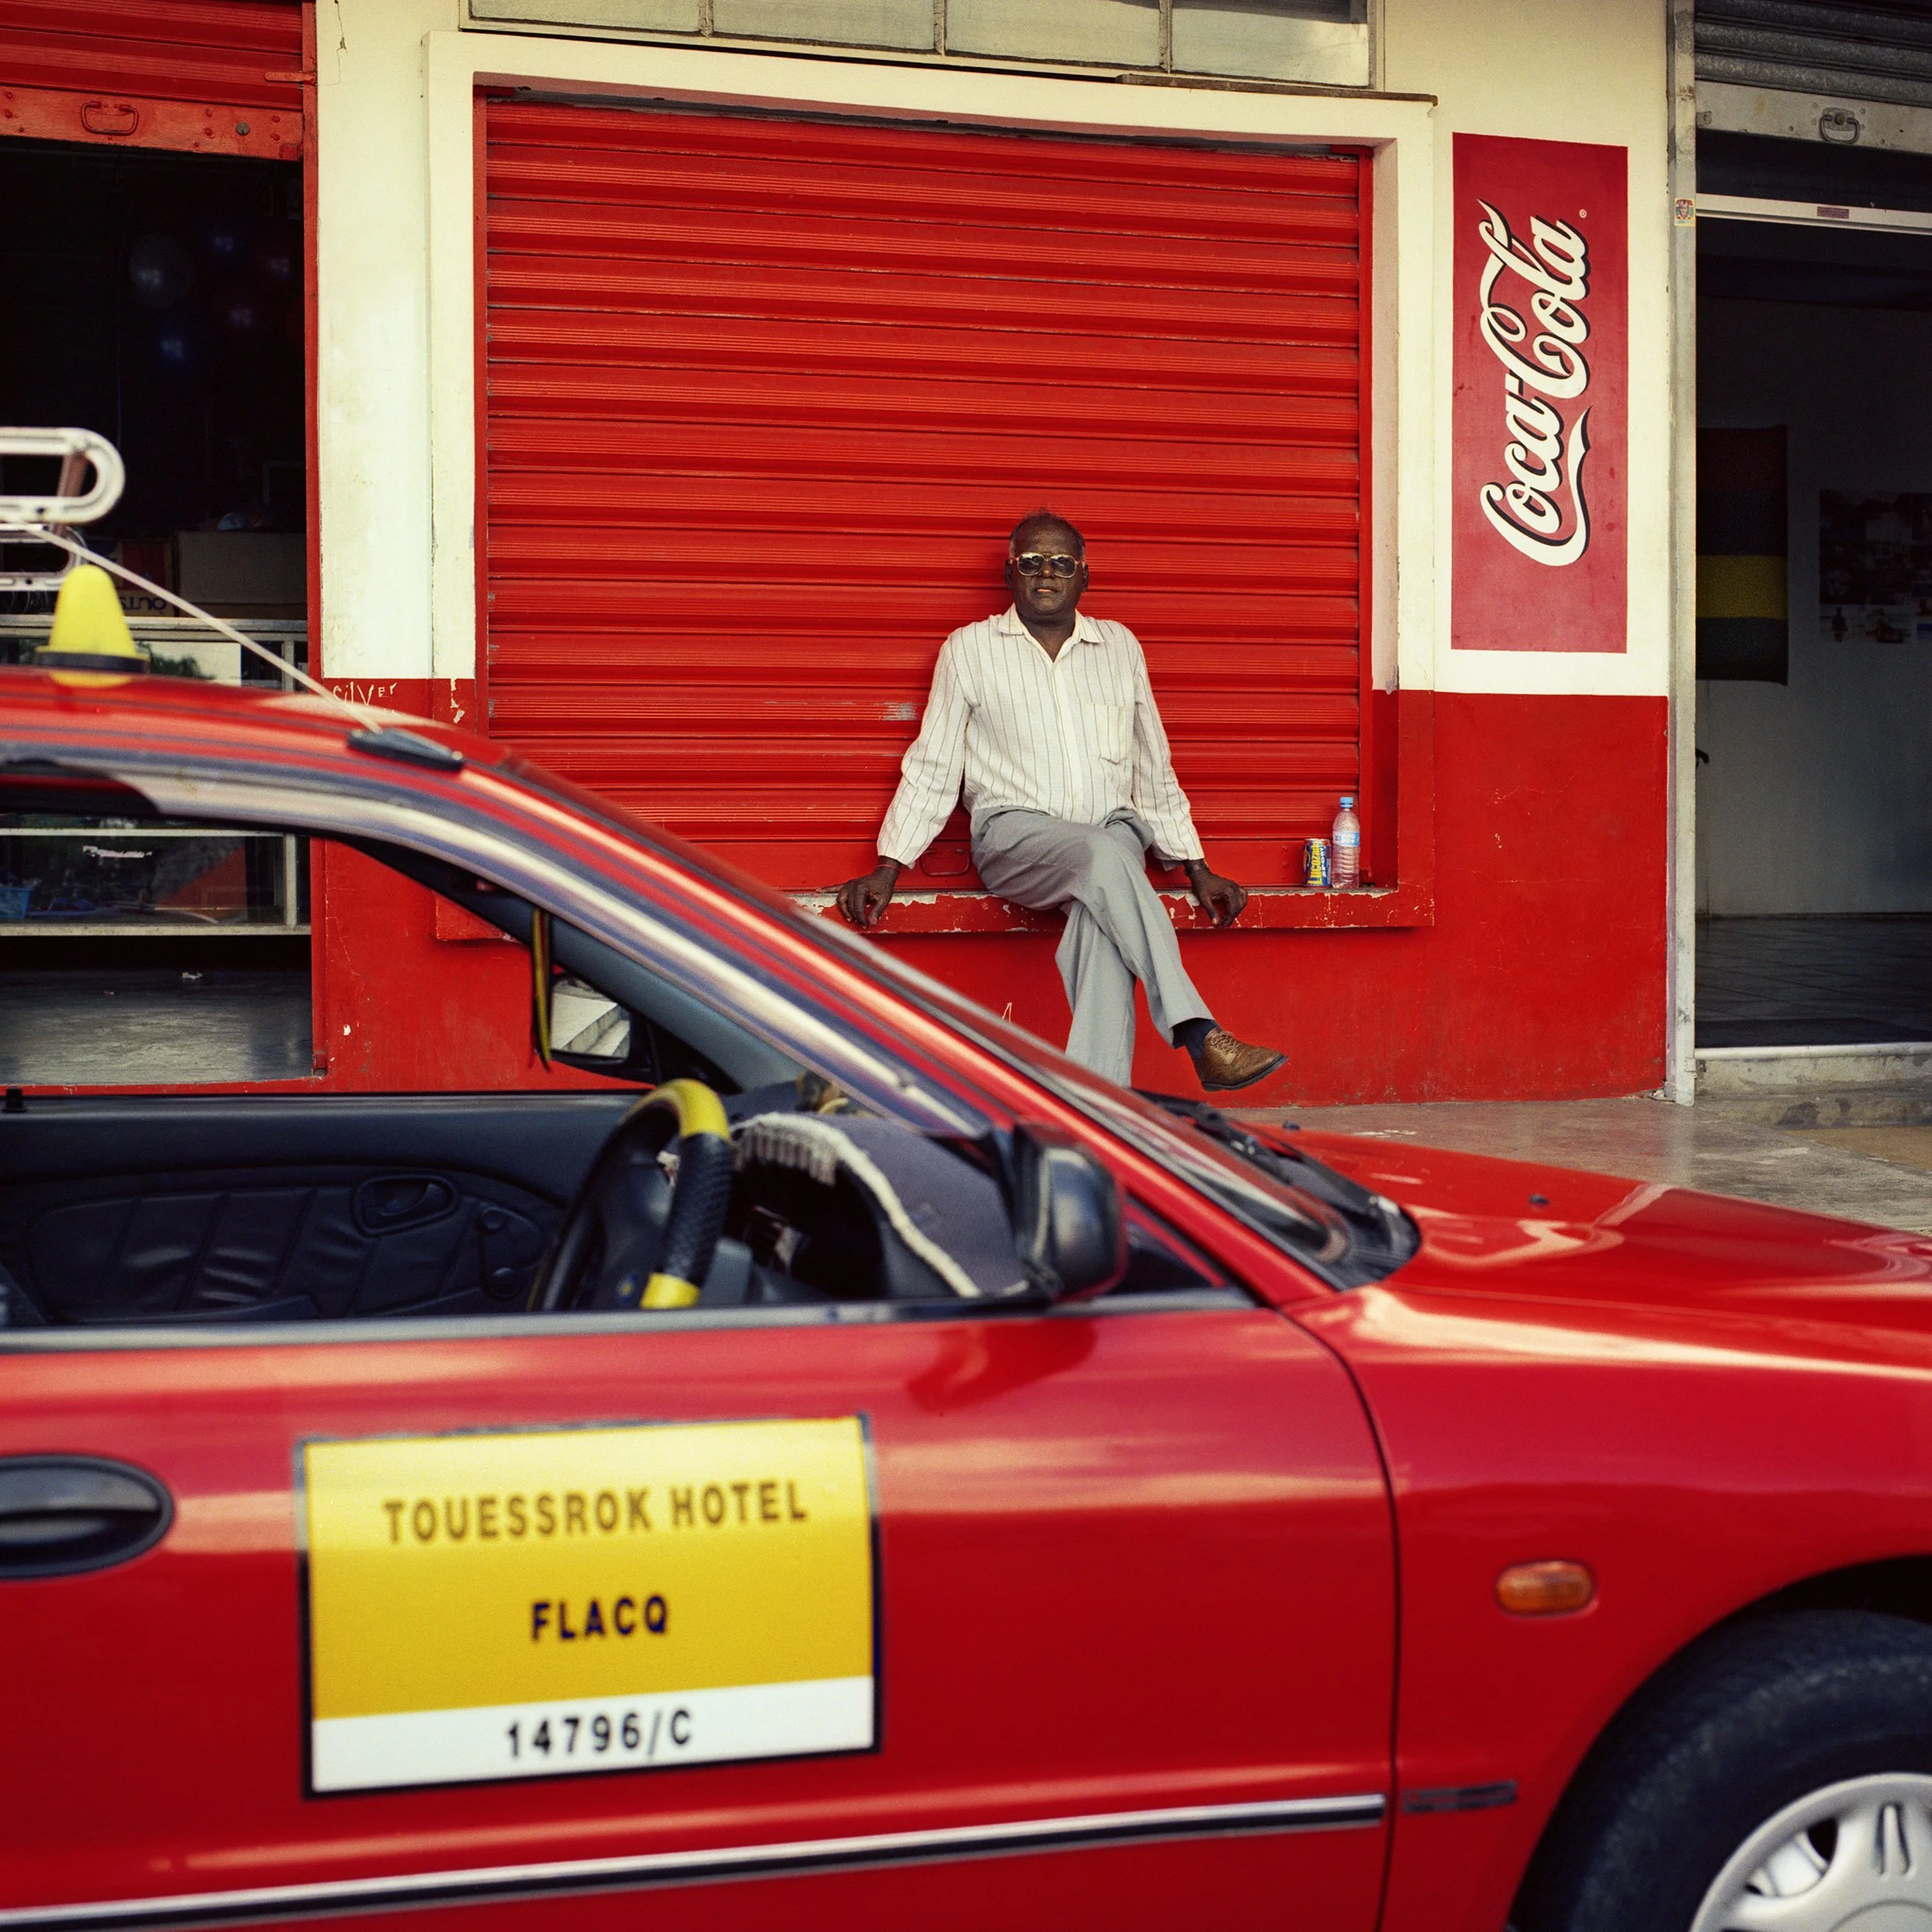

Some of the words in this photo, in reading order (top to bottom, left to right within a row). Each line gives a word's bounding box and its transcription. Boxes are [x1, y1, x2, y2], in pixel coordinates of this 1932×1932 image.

[1477, 198, 1591, 566] Coca-Cola
[383, 1487, 652, 1543] TOUESSROK
[670, 1480, 808, 1528] HOTEL
[531, 1593, 669, 1642] FLACQ
[508, 1709, 691, 1758] 14796/C
